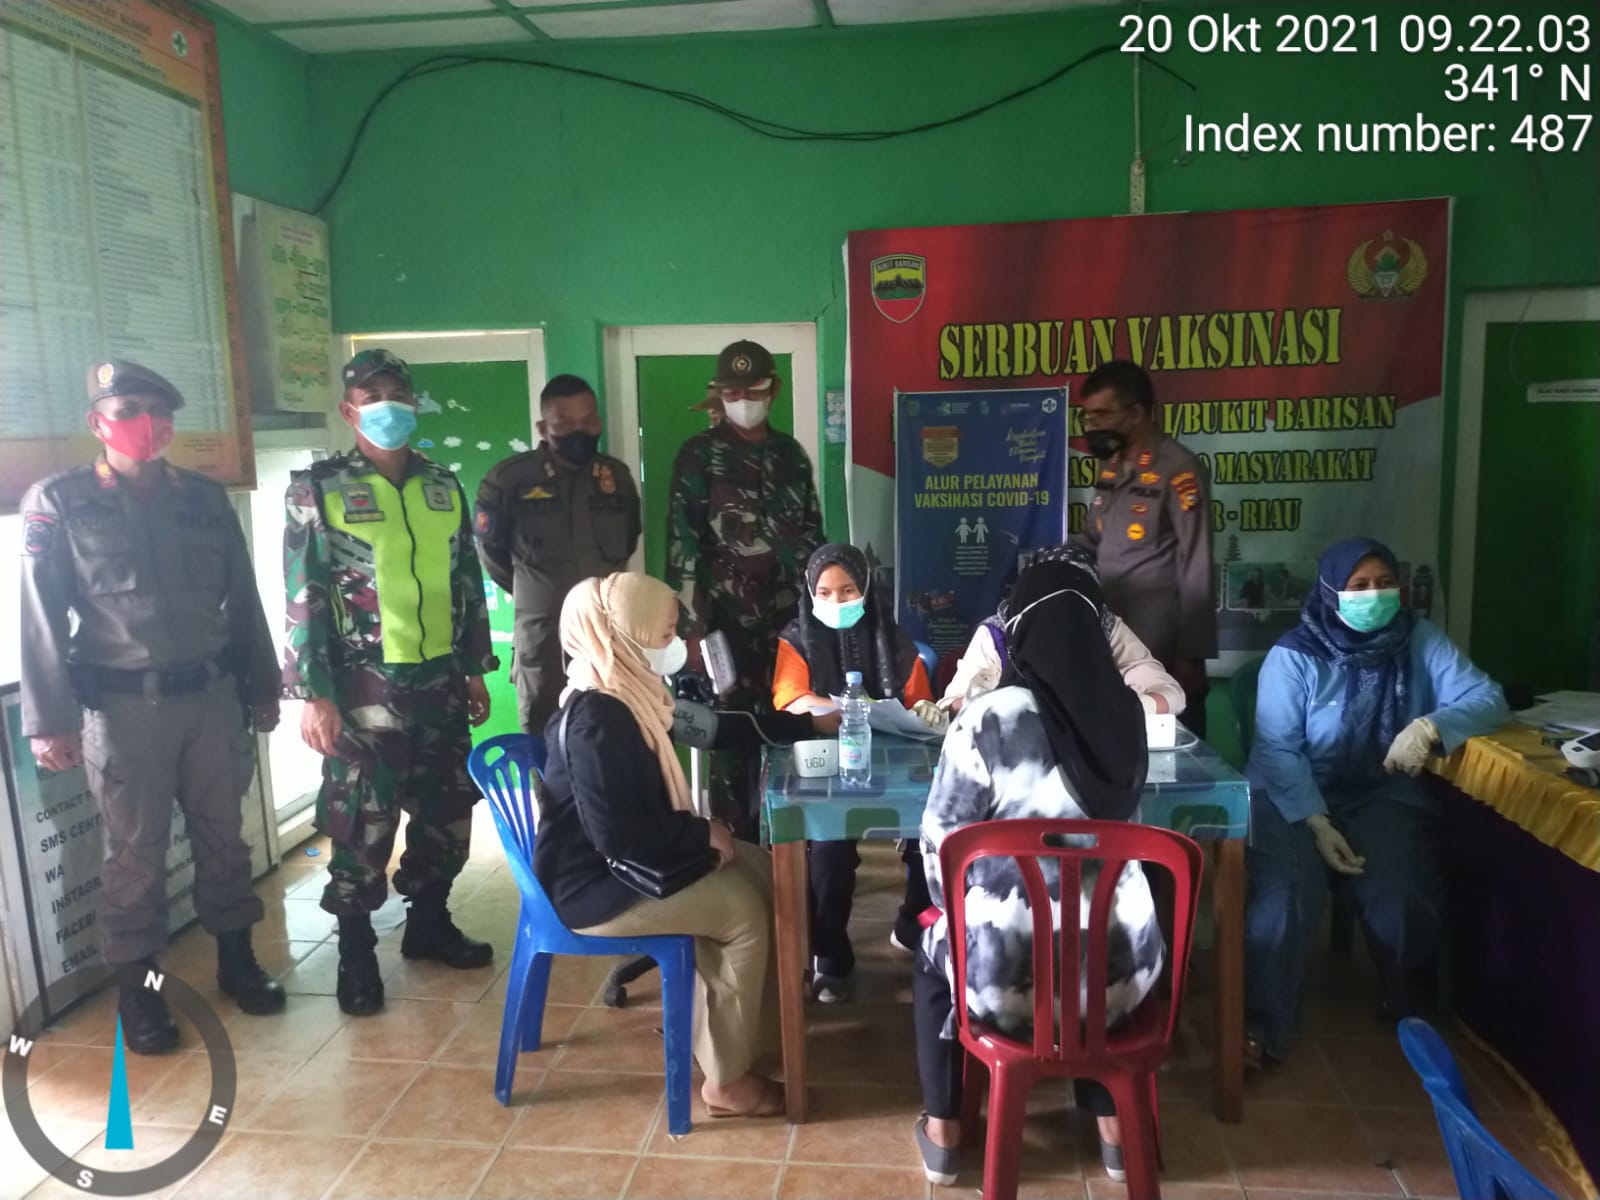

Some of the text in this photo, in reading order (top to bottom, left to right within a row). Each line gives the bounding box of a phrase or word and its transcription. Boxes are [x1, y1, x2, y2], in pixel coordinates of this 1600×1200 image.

[938, 307, 1343, 380] SERBUAN VAKSINASI
[1274, 396, 1397, 432] BARISAN
[925, 473, 1039, 491] ALUR PELAYANAN
[1214, 448, 1376, 484] MASYARAKAT
[914, 490, 1050, 509] VAKSINASI COVID-19
[1240, 498, 1302, 532] RIAU
[805, 757, 826, 769] UGD
[36, 792, 83, 824] CONTACT
[40, 812, 103, 854] SMS CENT
[45, 863, 64, 884] WA
[51, 875, 102, 915] INSTAGR
[62, 943, 98, 974] EMAIL
